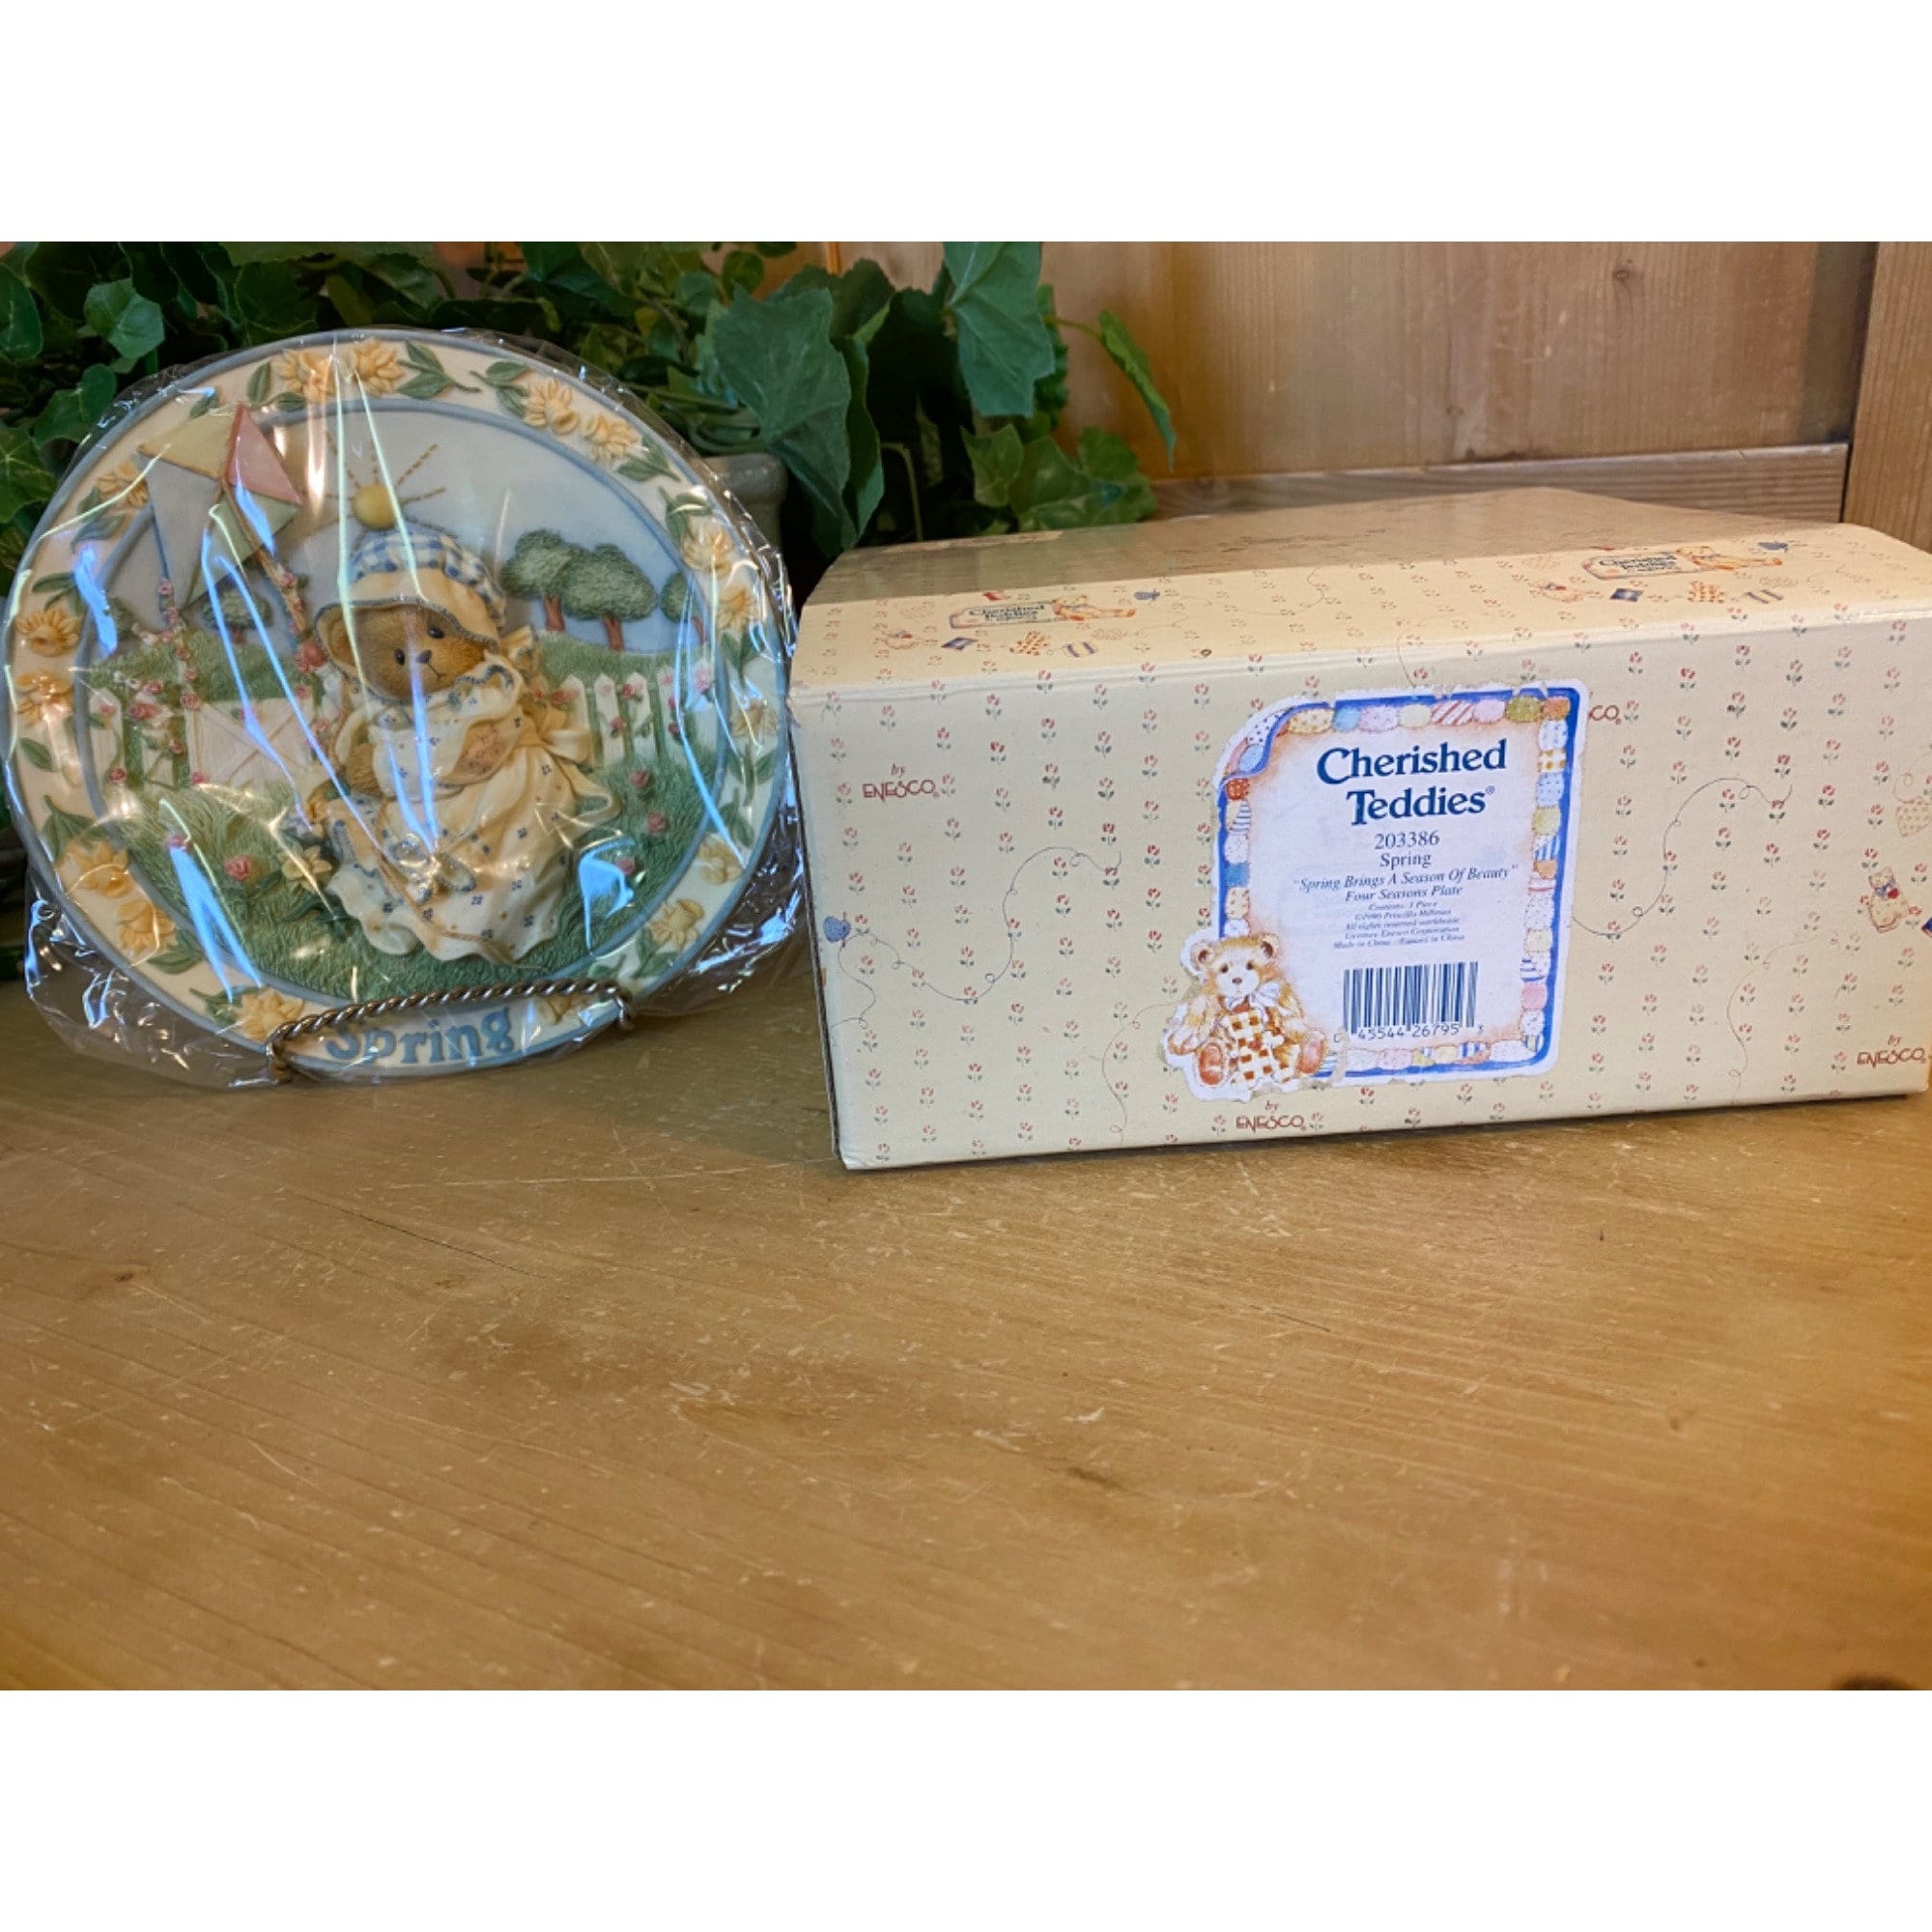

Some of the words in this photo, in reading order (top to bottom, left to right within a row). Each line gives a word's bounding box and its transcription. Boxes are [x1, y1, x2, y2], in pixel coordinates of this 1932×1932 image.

[1317, 738, 1507, 784] Cherished
[1374, 830, 1440, 850] 203386
[1378, 851, 1432, 870] Spring
[1344, 873, 1385, 889] Brings
[1388, 875, 1398, 885] A
[1401, 871, 1445, 885] Season
[1448, 868, 1464, 883] Of
[1345, 890, 1377, 902] Four
[1378, 887, 1428, 900] Seasons
[1431, 884, 1463, 896] Plate
